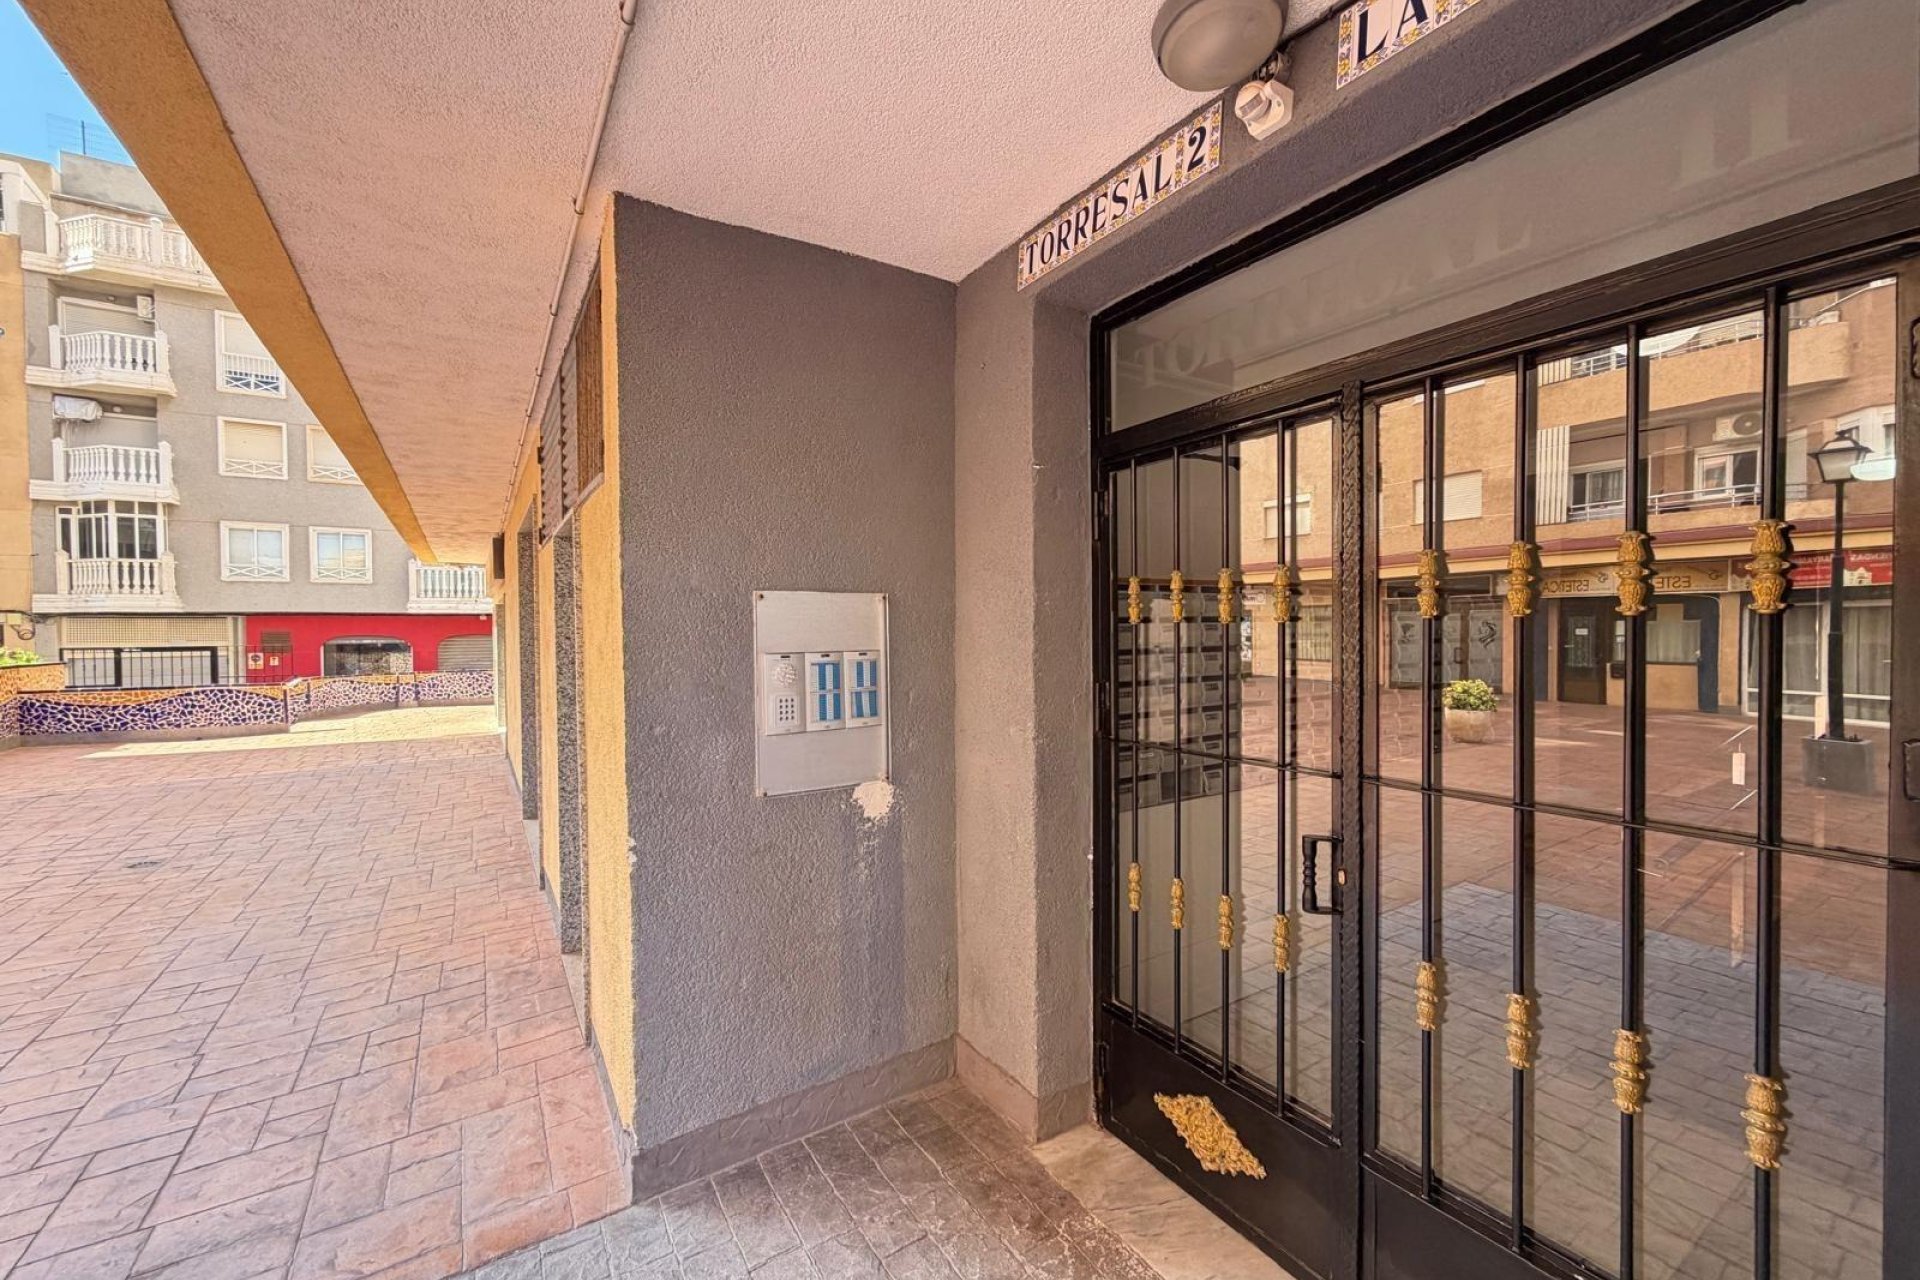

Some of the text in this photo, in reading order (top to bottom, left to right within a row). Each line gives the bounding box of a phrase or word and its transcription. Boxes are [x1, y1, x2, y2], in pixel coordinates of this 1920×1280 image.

[1357, 0, 1428, 63] LA
[1026, 125, 1207, 275] TORRESAL 2
